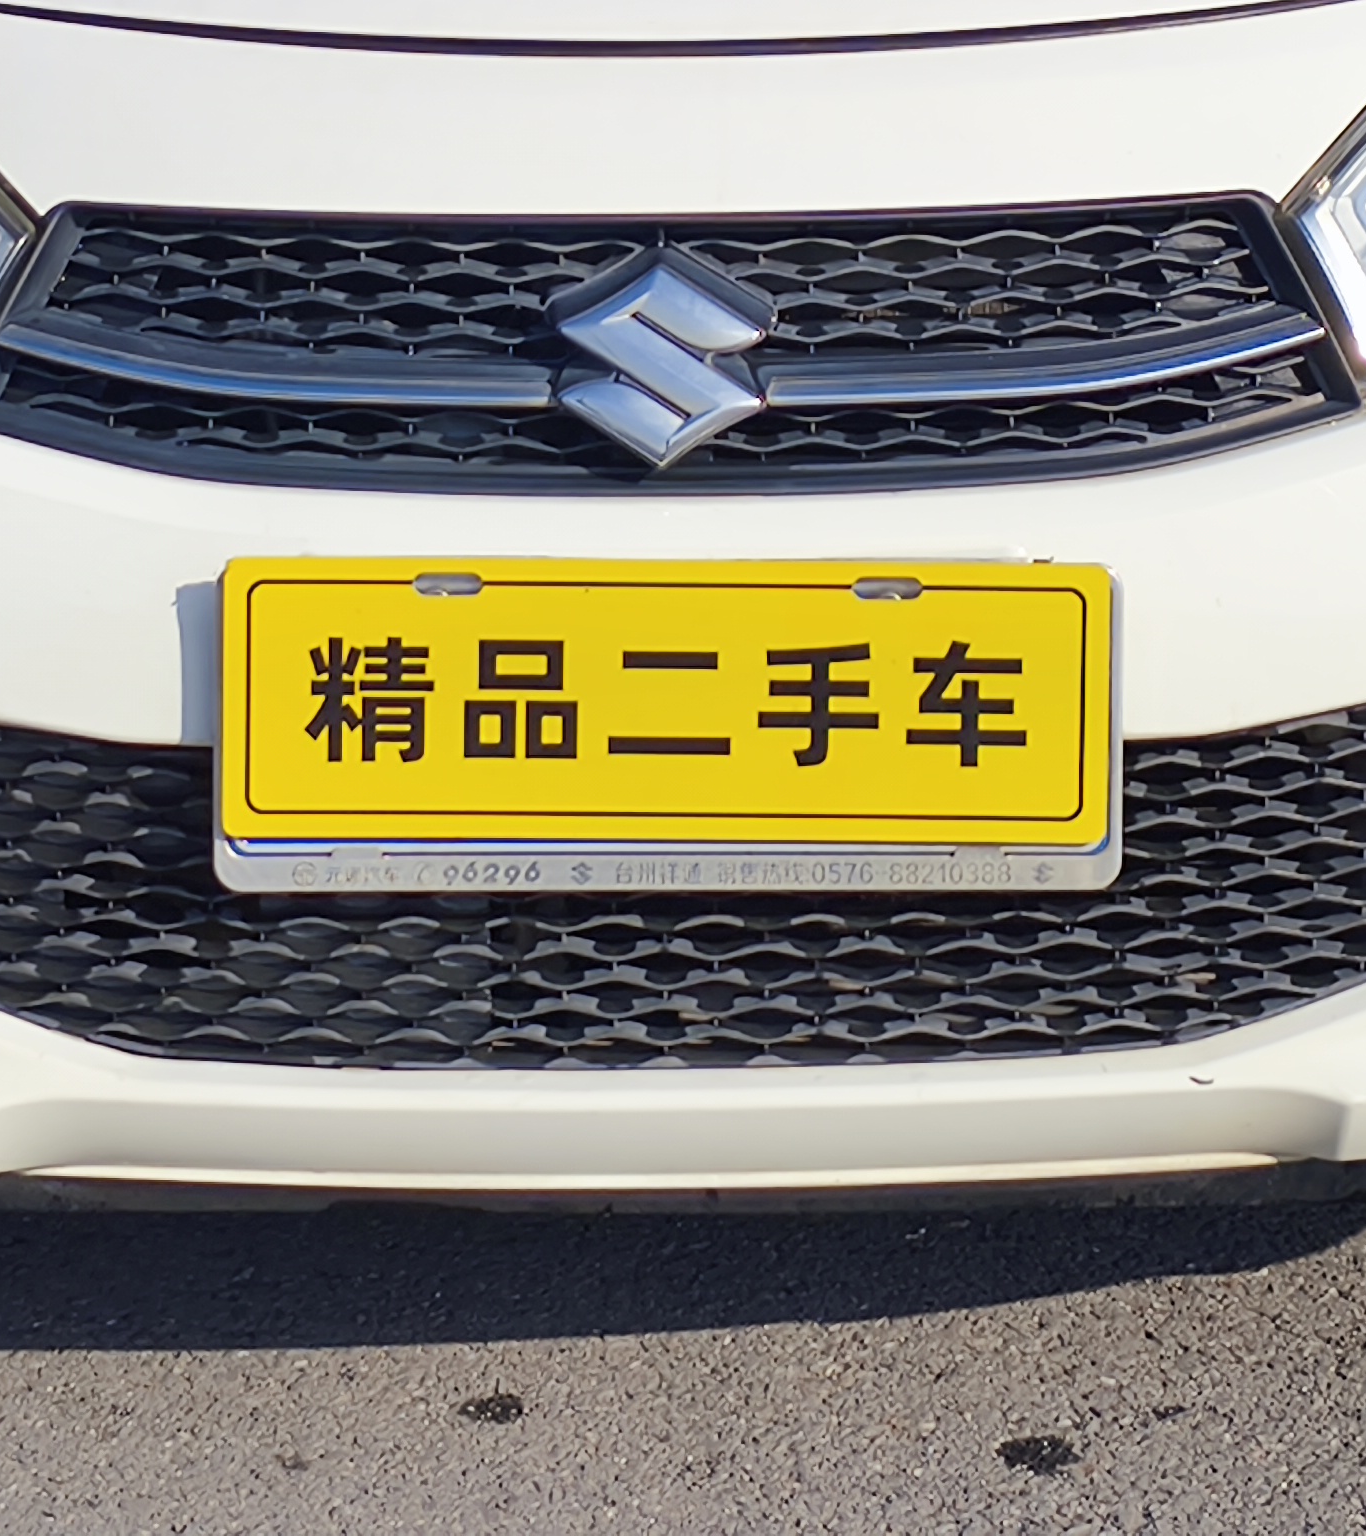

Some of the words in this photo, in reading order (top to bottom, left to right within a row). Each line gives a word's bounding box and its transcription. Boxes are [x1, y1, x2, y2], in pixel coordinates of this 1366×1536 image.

[303, 635, 1028, 768] 精品二手车
[442, 860, 541, 886] 96296
